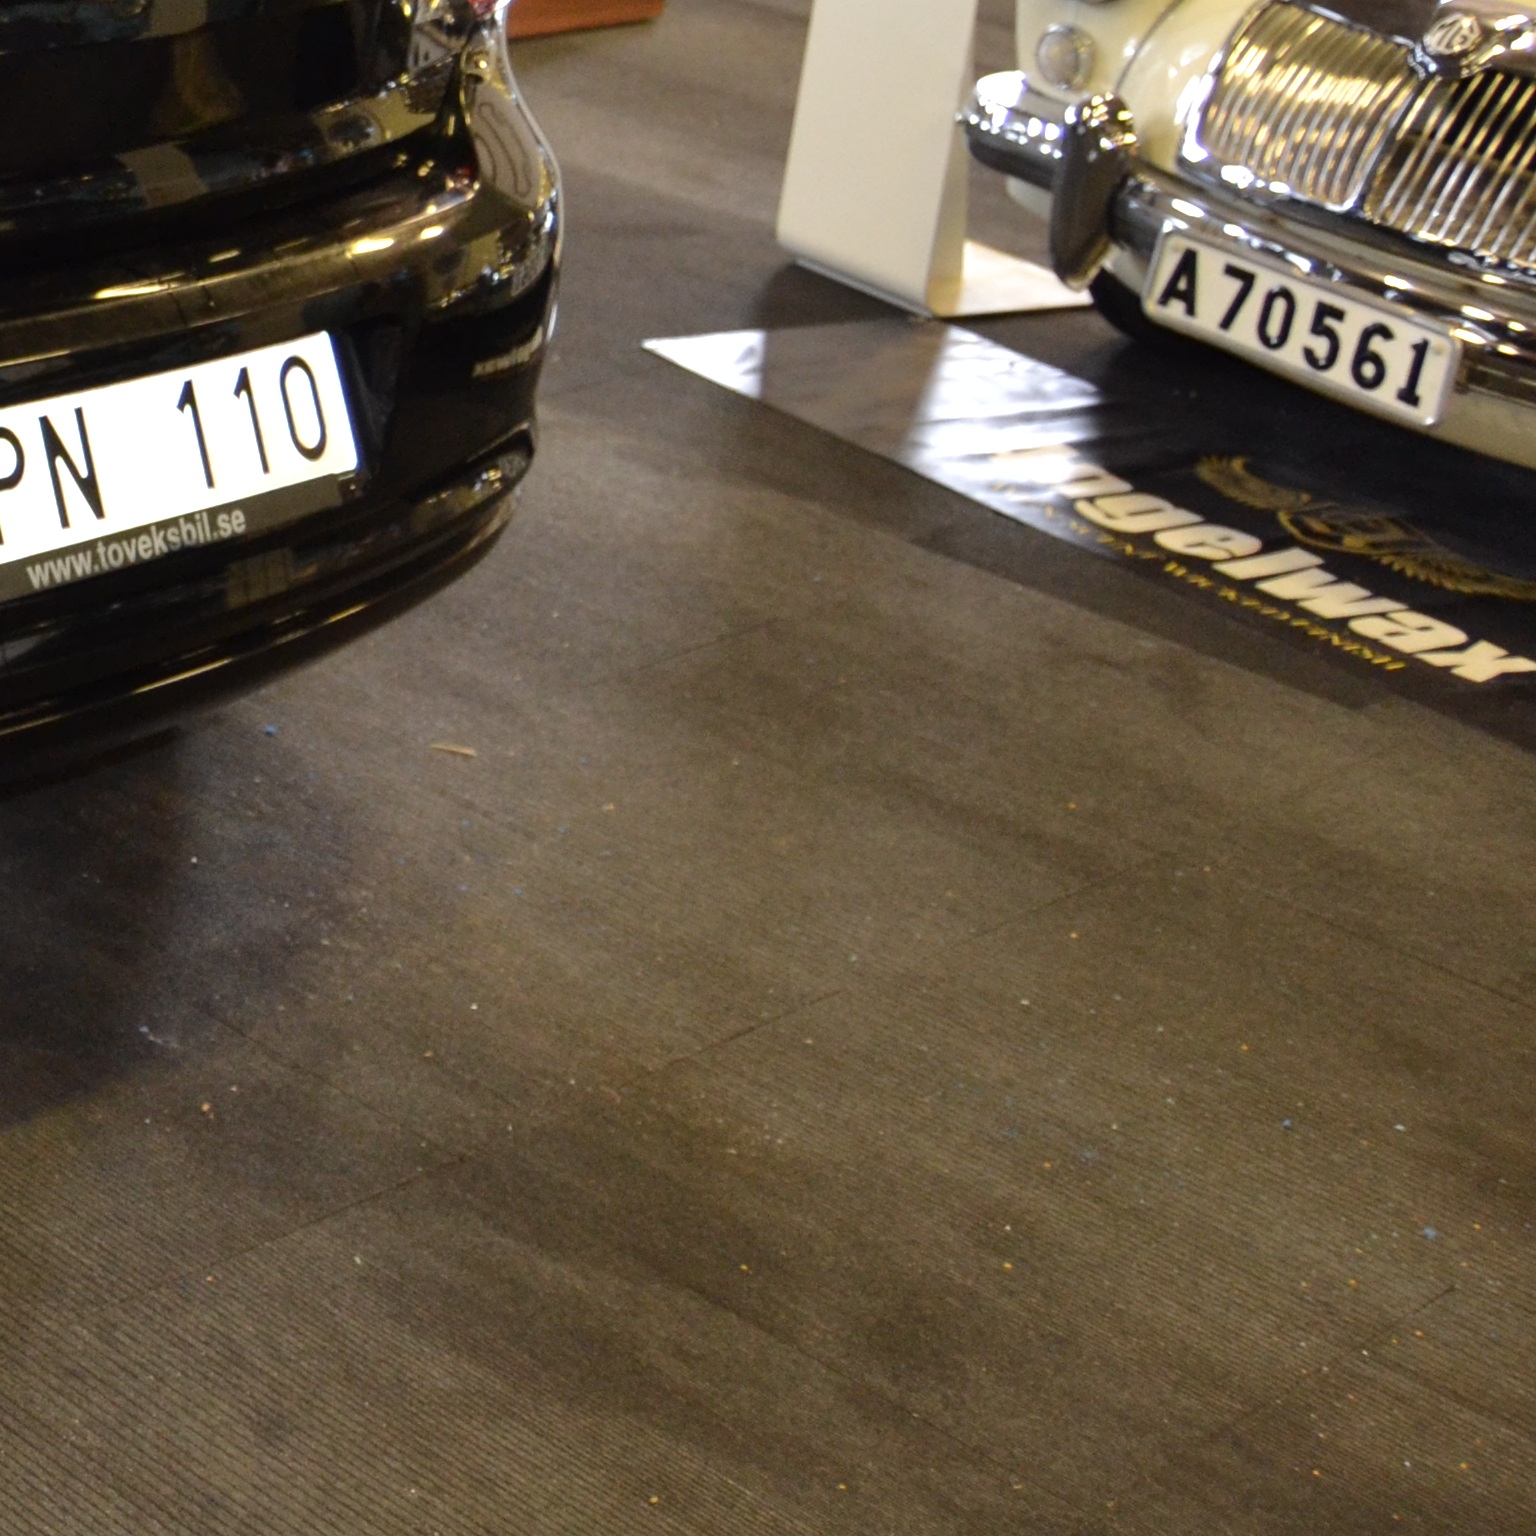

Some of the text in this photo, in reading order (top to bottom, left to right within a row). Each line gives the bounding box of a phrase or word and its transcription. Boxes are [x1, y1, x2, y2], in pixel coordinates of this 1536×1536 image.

[1157, 248, 1430, 408] A70561
[176, 355, 327, 489] 110
[26, 509, 246, 589] www.toveksbil.se
[988, 443, 1536, 684] ngelwax
